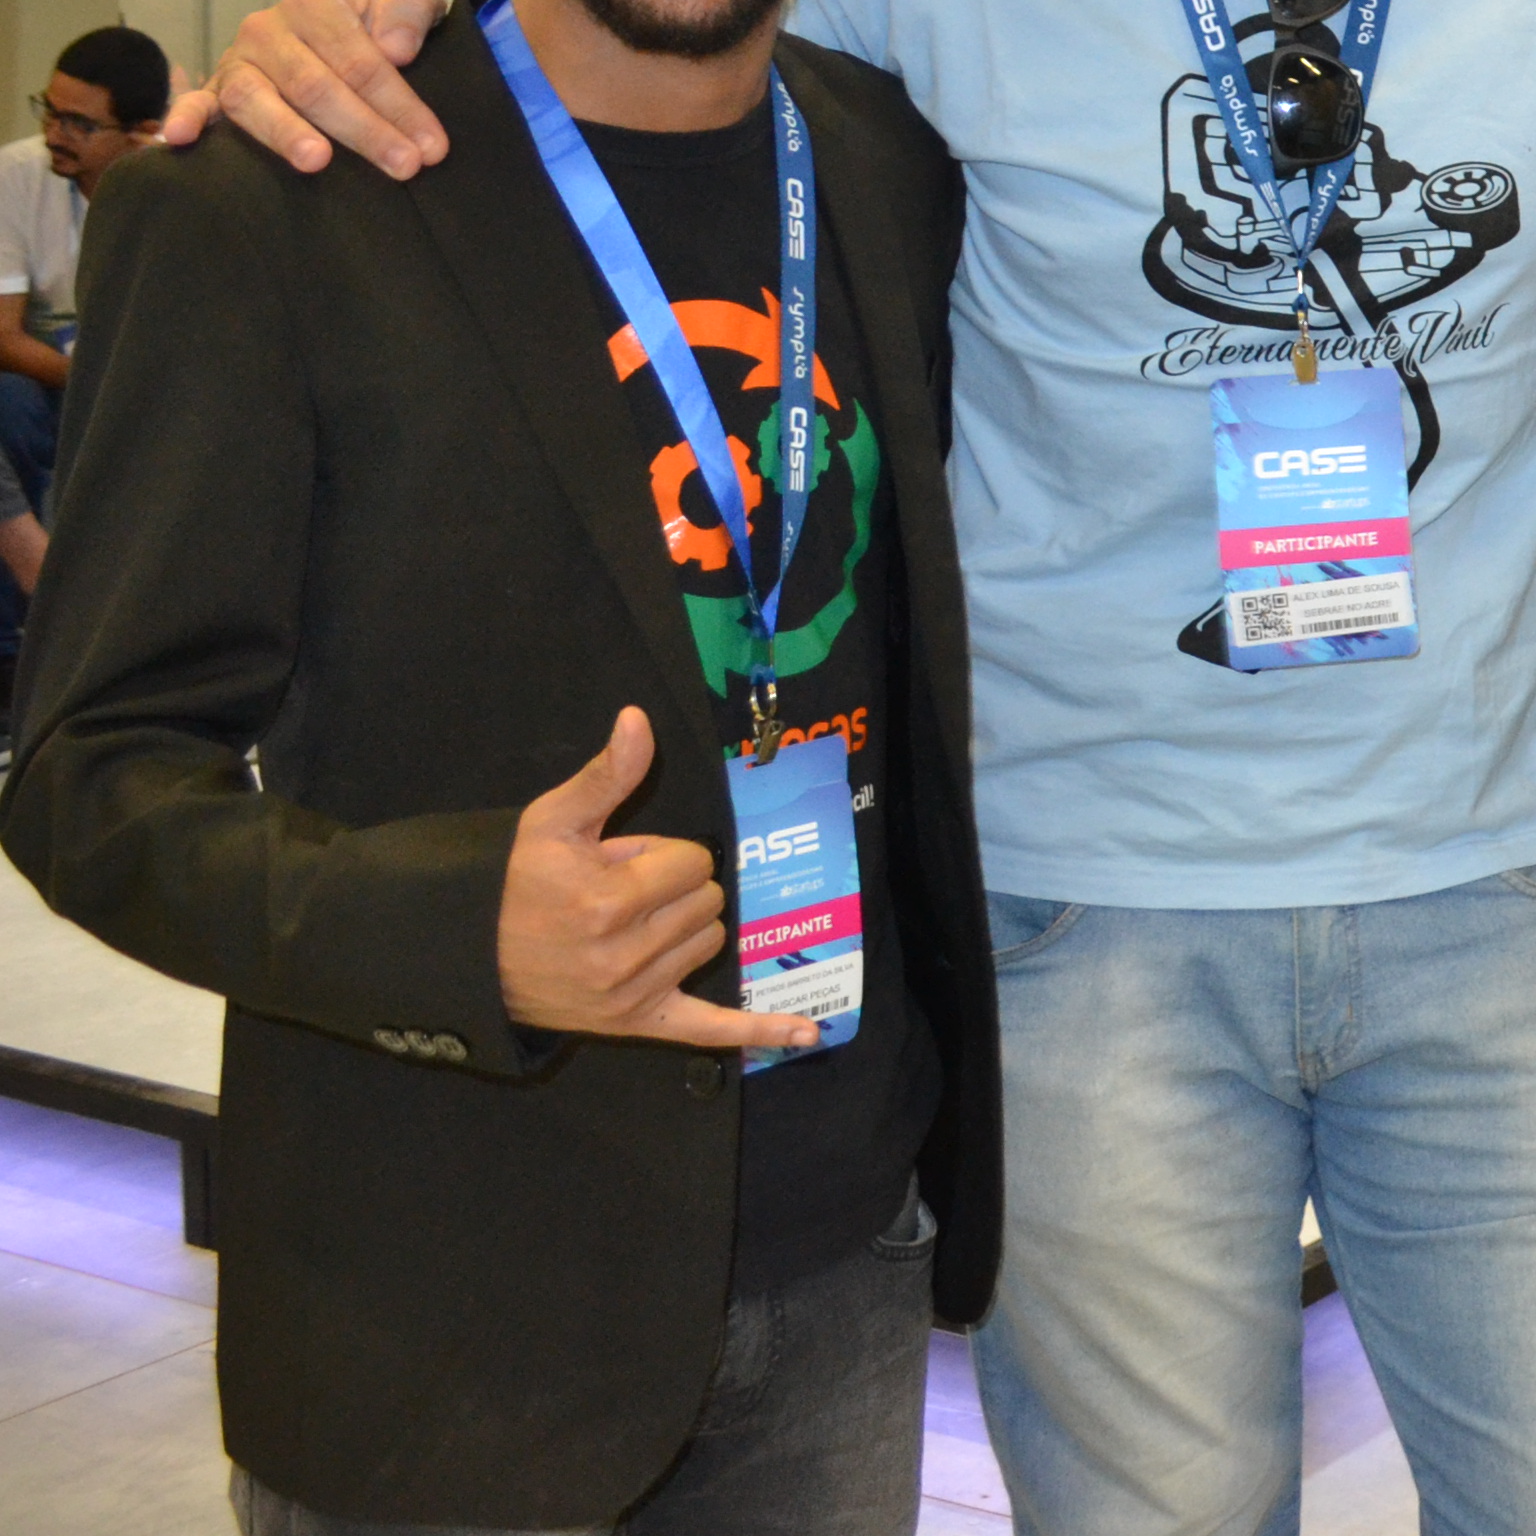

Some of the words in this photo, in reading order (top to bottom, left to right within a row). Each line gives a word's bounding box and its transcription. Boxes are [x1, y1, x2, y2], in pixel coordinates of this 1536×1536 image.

[777, 82, 803, 153] ympla
[786, 177, 806, 261] CASE
[789, 406, 808, 493] CASE
[1254, 444, 1368, 480] CASE
[1254, 531, 1379, 555] PARTICIPANTE
[1293, 591, 1320, 602] ALEX
[1322, 588, 1346, 599] LIMA
[1347, 585, 1361, 595] DE
[1363, 581, 1400, 593] SOUSA
[1303, 605, 1345, 618] SEBRAE
[852, 783, 875, 812] cil!
[737, 821, 820, 871] ASE
[739, 913, 833, 952] RTICIPANTE
[769, 993, 809, 1013] BUSCAR
